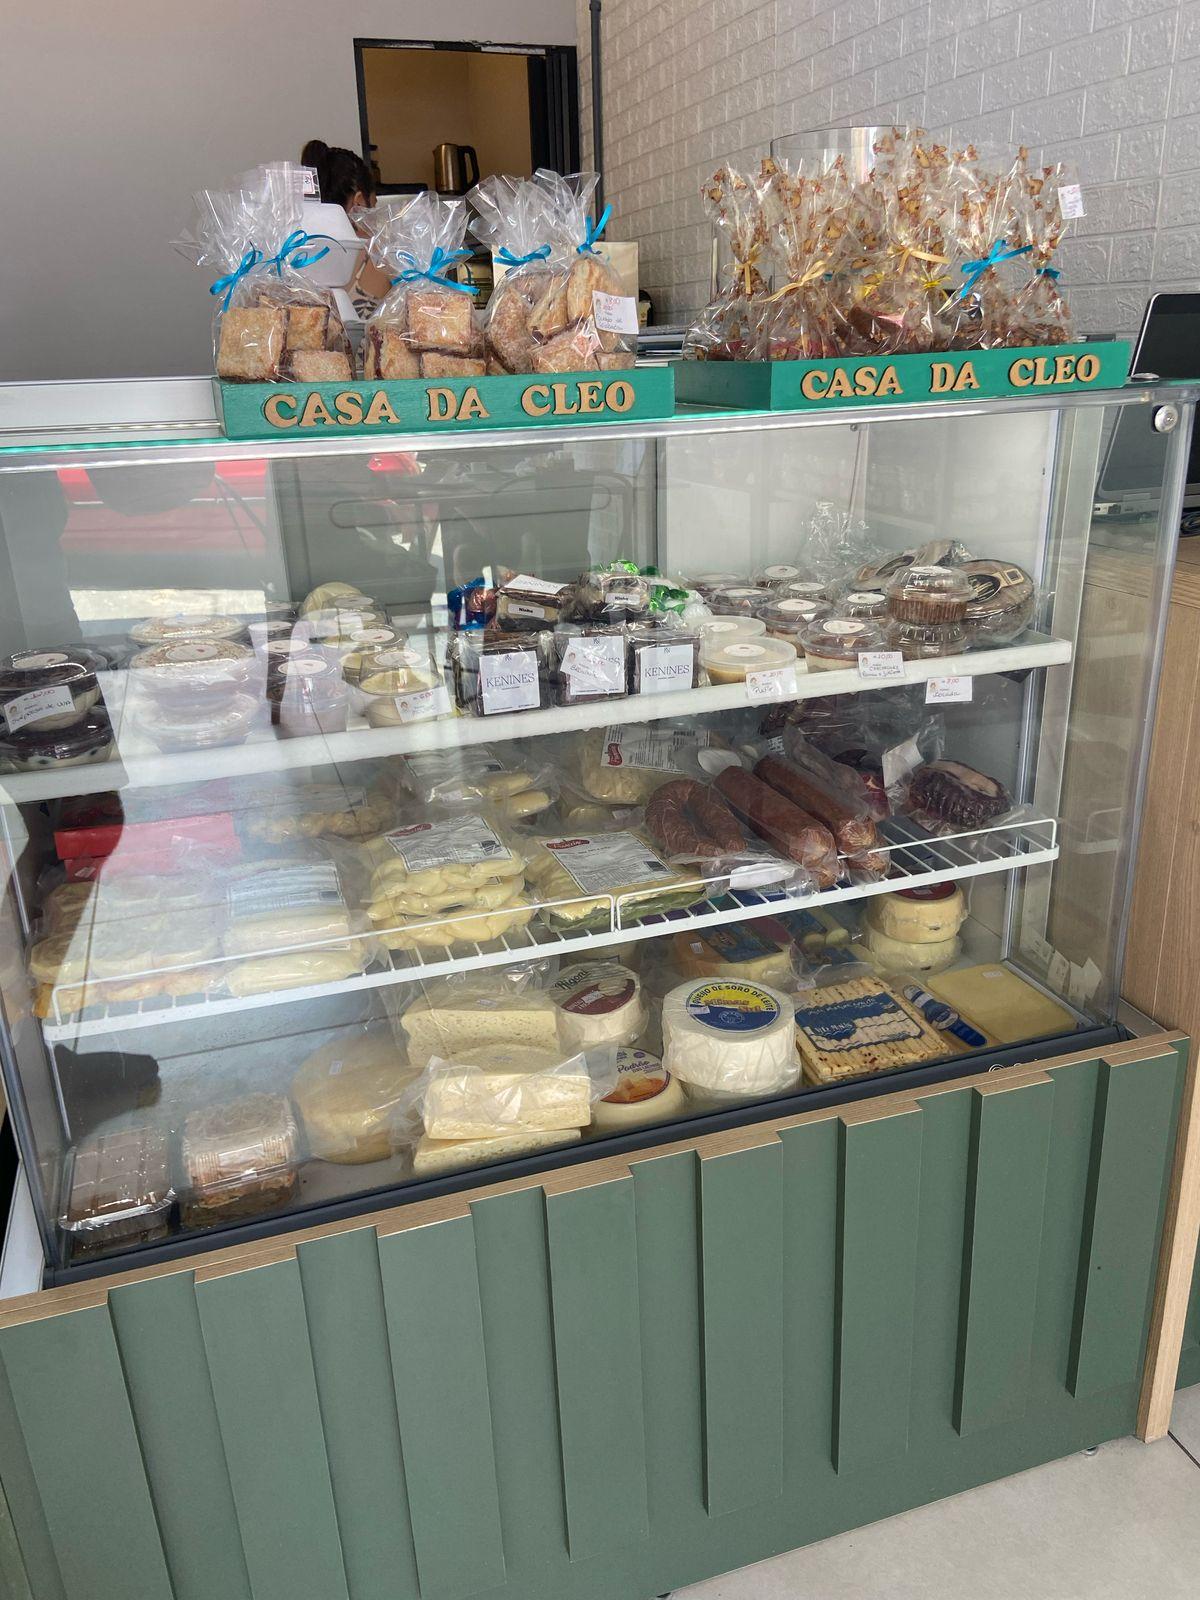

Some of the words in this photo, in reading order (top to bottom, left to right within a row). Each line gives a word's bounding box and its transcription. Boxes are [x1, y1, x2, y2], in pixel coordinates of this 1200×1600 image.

[801, 366, 903, 400] CASA
[929, 361, 980, 393] DA
[1008, 354, 1100, 387] CLEO
[263, 390, 400, 429] CASA
[426, 386, 490, 421] DA
[521, 380, 635, 417] CLEO
[486, 672, 536, 687] KENINES
[644, 664, 690, 678] KENINES
[554, 969, 591, 990] Rigoni
[692, 988, 711, 1005] QUEIJO
[724, 985, 750, 993] SORO
[750, 990, 763, 998] DE
[760, 996, 774, 1011] LEITE
